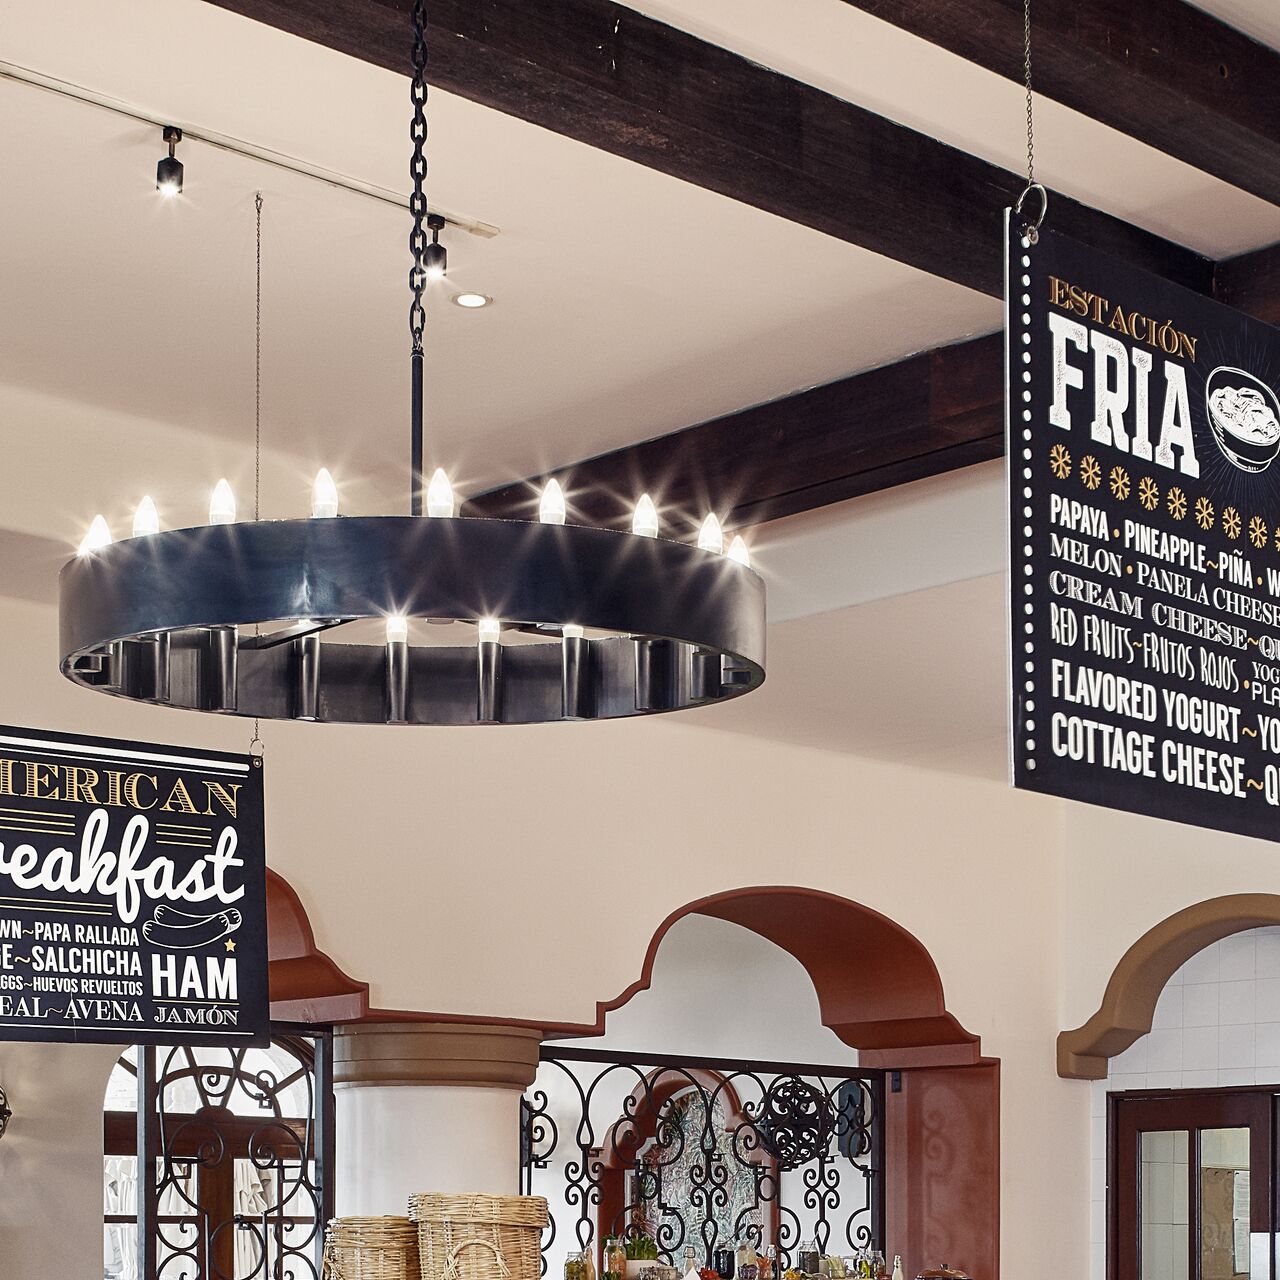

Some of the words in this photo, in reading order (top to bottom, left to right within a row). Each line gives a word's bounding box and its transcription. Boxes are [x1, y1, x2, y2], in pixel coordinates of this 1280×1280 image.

[1049, 275, 1197, 363] ESTACIÓN
[1049, 311, 1200, 480] FRIA
[1050, 493, 1110, 542] PAPAYA
[1124, 519, 1207, 573] PINEAPPLE
[1219, 549, 1254, 589] PIÑA
[1050, 532, 1123, 578] MELON
[1136, 561, 1211, 606] PANELA
[1049, 570, 1144, 620] CREAM
[1151, 602, 1248, 650] CHEESE
[1050, 602, 1078, 646] RED
[1084, 614, 1135, 664] FRUITS
[1143, 631, 1195, 681] FRUTOS
[1200, 646, 1240, 693] ROJOS
[1052, 658, 1157, 722] FLAVORED
[1162, 689, 1241, 744] YOGURT
[1052, 712, 1156, 778] COTTAGE
[1162, 740, 1247, 798] CHEESE
[32, 945, 143, 977] SALCHICHA
[34, 921, 72, 943] PAPA
[75, 923, 139, 947] RALLADA
[33, 976, 78, 994] HUEVOS
[81, 978, 143, 996] REVUELTOS
[65, 998, 145, 1023] AVENA
[151, 953, 238, 1001] HAM
[154, 1004, 239, 1026] JAMÓN
